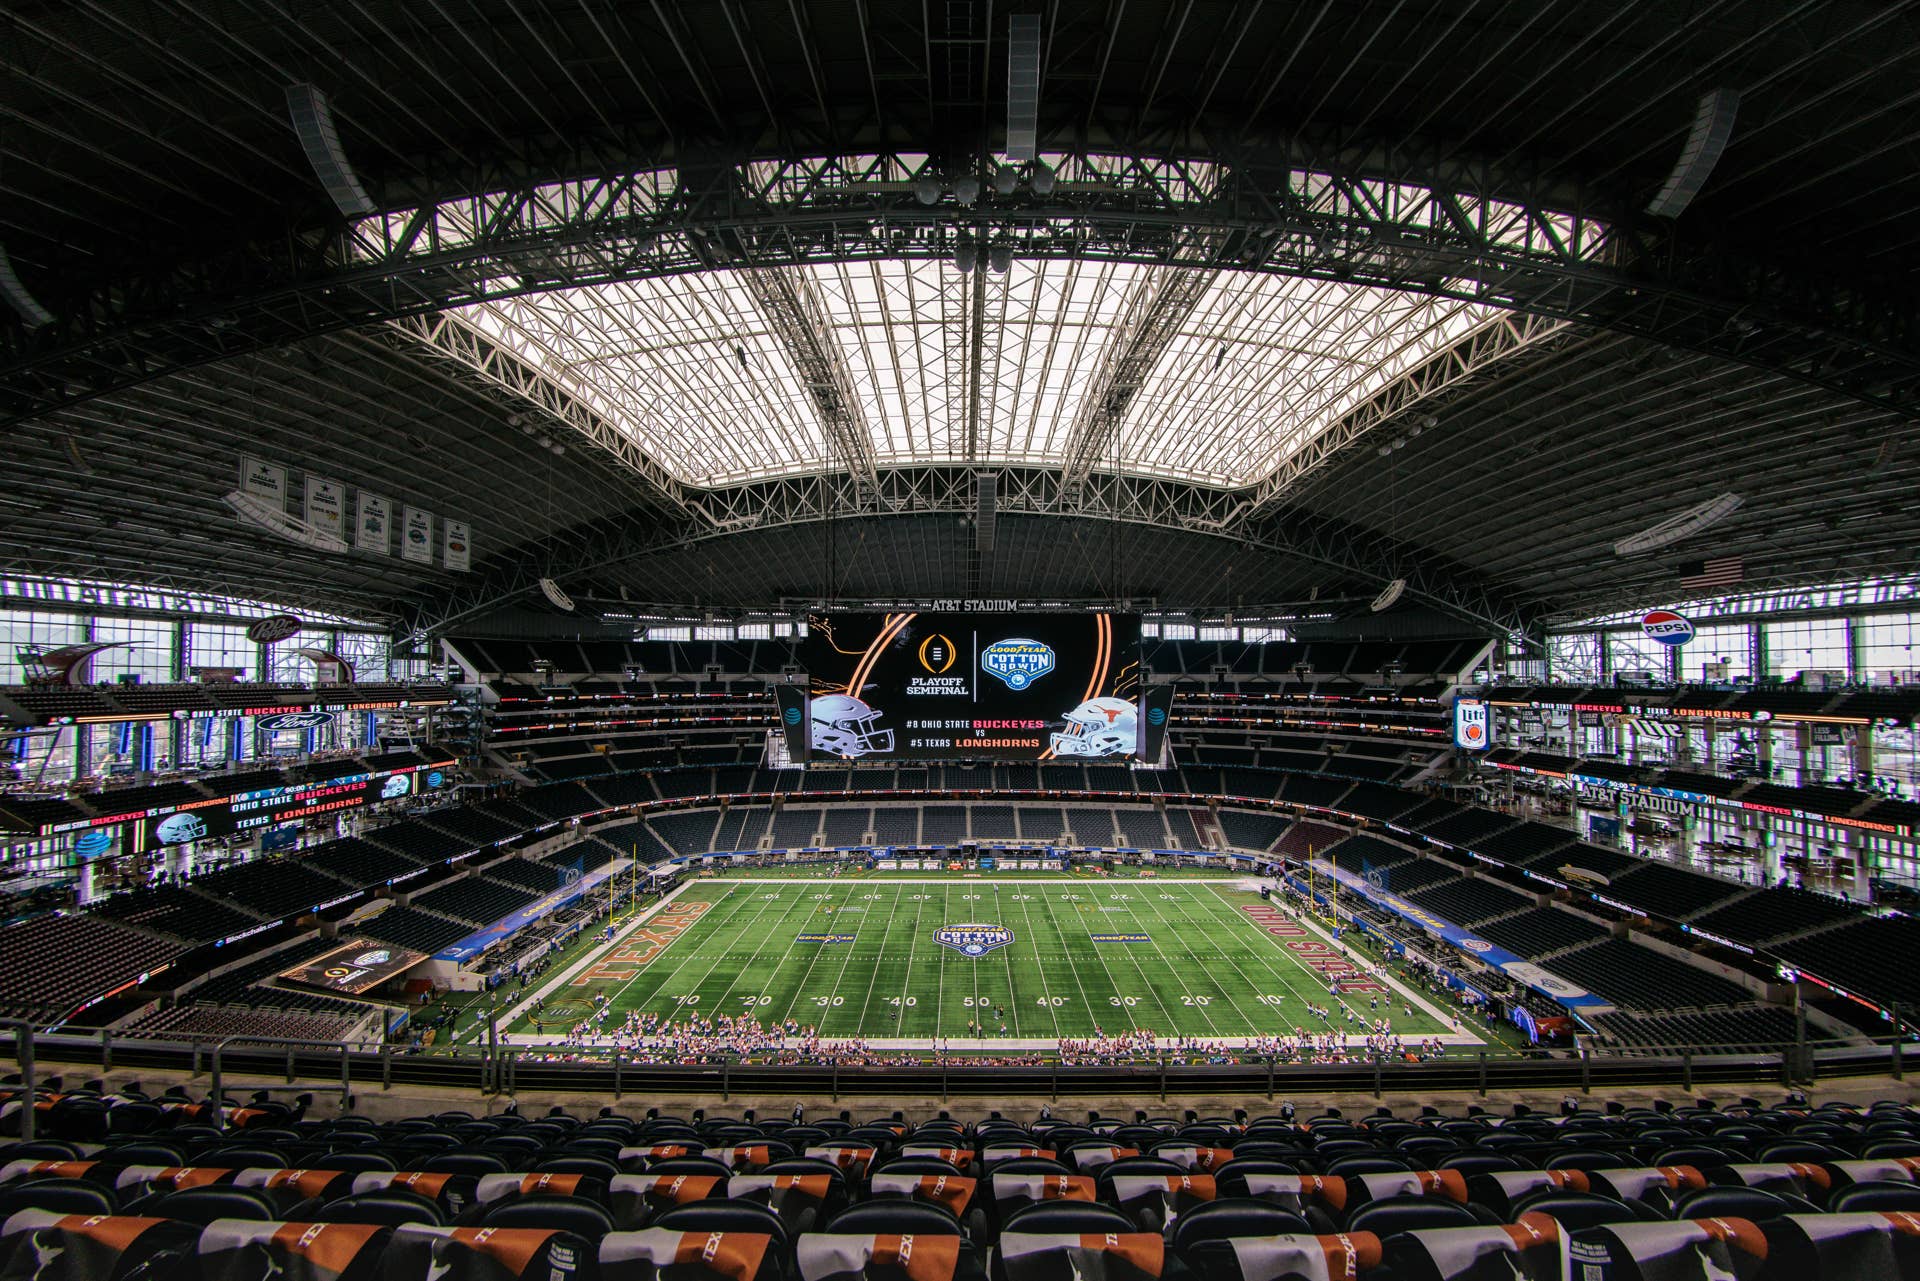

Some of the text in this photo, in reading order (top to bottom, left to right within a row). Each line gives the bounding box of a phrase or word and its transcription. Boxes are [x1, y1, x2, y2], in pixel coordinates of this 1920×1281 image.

[932, 599, 1018, 611] AT&T STADIUM
[1646, 623, 1689, 633] PEPSI
[990, 645, 1047, 654] GOODYEAR
[988, 654, 1049, 670] COTTON
[1000, 663, 1038, 672] BOWL
[911, 677, 964, 686] PLAYOFF
[906, 686, 969, 695] SEMIFINAL
[217, 709, 243, 717] STATE
[245, 706, 303, 715] BUCKEYES
[348, 702, 398, 710] LONGHORNS
[1574, 704, 1623, 713] BUCKEYES
[1630, 706, 1642, 714] VS
[1645, 707, 1669, 715] TEXAS
[1673, 708, 1751, 719] LONGHORNS
[1462, 709, 1484, 722] Lite
[270, 714, 323, 729] Ford
[906, 720, 1045, 729] #8 OHIO STATE BUCKEYES
[975, 729, 985, 737] VS
[1630, 718, 1684, 740] Lite
[910, 739, 1040, 748] #5 TEXAS LONGHORNS
[231, 782, 367, 812] OHIO STATE BUCKEYES
[306, 798, 317, 806] VS
[1581, 785, 1697, 818] AT&T STADIUM
[91, 811, 145, 826] BUCKEYES
[147, 808, 158, 817] VS
[176, 797, 229, 811] LONGHORNS
[236, 797, 363, 828] TEXAS LONGHORNS
[1744, 803, 1791, 816] BUCKEYES
[1793, 809, 1804, 819] VS
[1825, 815, 1896, 833] LONGHORNS
[319, 890, 365, 911] Blockchain.com
[225, 919, 284, 945] Blockchain.com
[940, 931, 1008, 942] COTTON
[567, 901, 712, 986] TEXAS
[1690, 927, 1754, 955] Blockchain.com
[1239, 904, 1388, 994] OHIO STATE
[677, 995, 701, 1006] 10
[743, 995, 773, 1006] 20
[816, 995, 845, 1006] 30
[887, 995, 917, 1006] 40
[963, 995, 990, 1006] 50
[1036, 995, 1062, 1006] 40
[1109, 995, 1136, 1006] 30
[1180, 995, 1208, 1006] 20
[1256, 995, 1281, 1006] 10
